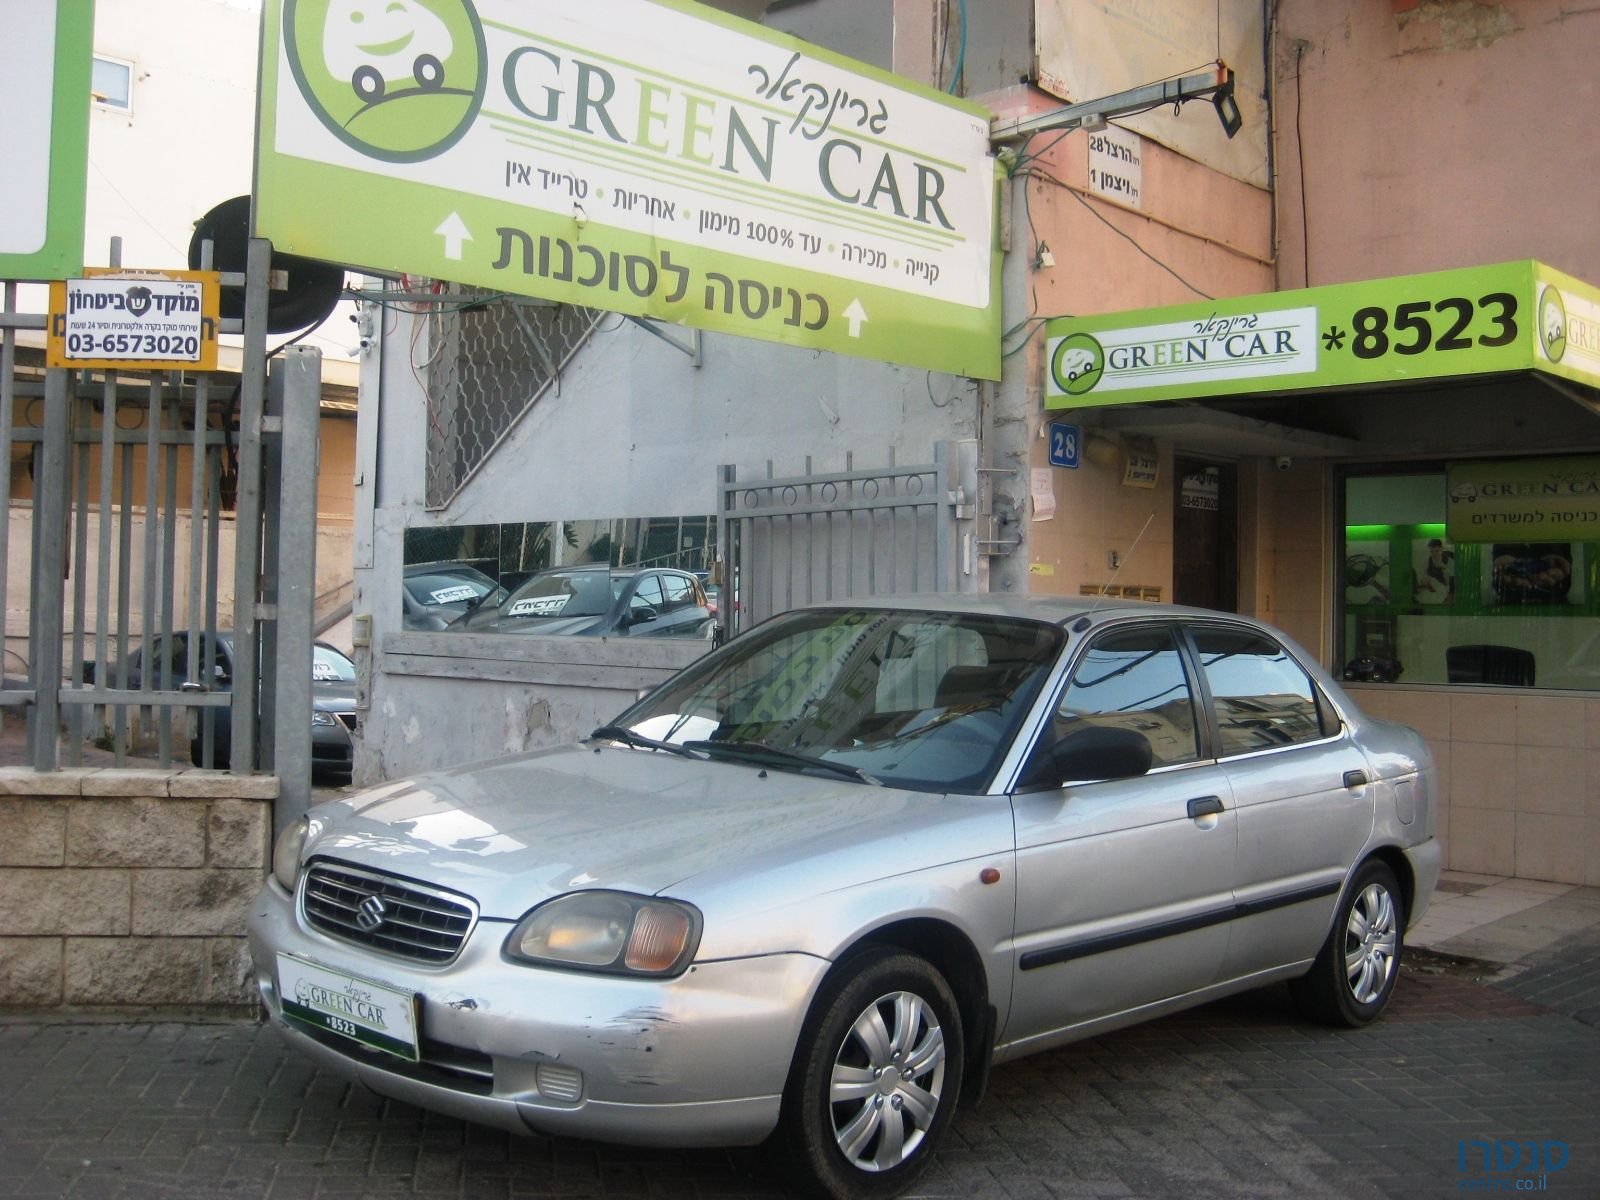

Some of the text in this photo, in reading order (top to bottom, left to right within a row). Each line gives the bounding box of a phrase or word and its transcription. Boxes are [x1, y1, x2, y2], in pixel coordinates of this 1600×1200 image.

[748, 51, 888, 140] גרינקאר
[502, 46, 956, 231] GREEN CAR
[1100, 171, 1130, 194] ויצמן
[505, 160, 940, 286] קנייה מכירה עד 100% מימון אחריות טרייד אין
[491, 226, 829, 331] כניסה לסוכנות
[69, 290, 126, 314] ביטחון
[151, 292, 200, 316] מוקד
[87, 321, 96, 330] 24
[1193, 311, 1259, 342] גרינקאר
[68, 333, 198, 355] 03-6573020
[1108, 329, 1299, 370] GREEN CAR
[1053, 431, 1076, 459] 28
[1471, 509, 1599, 525] כניסה למשרדים
[310, 986, 385, 1025] GREEN CAR
